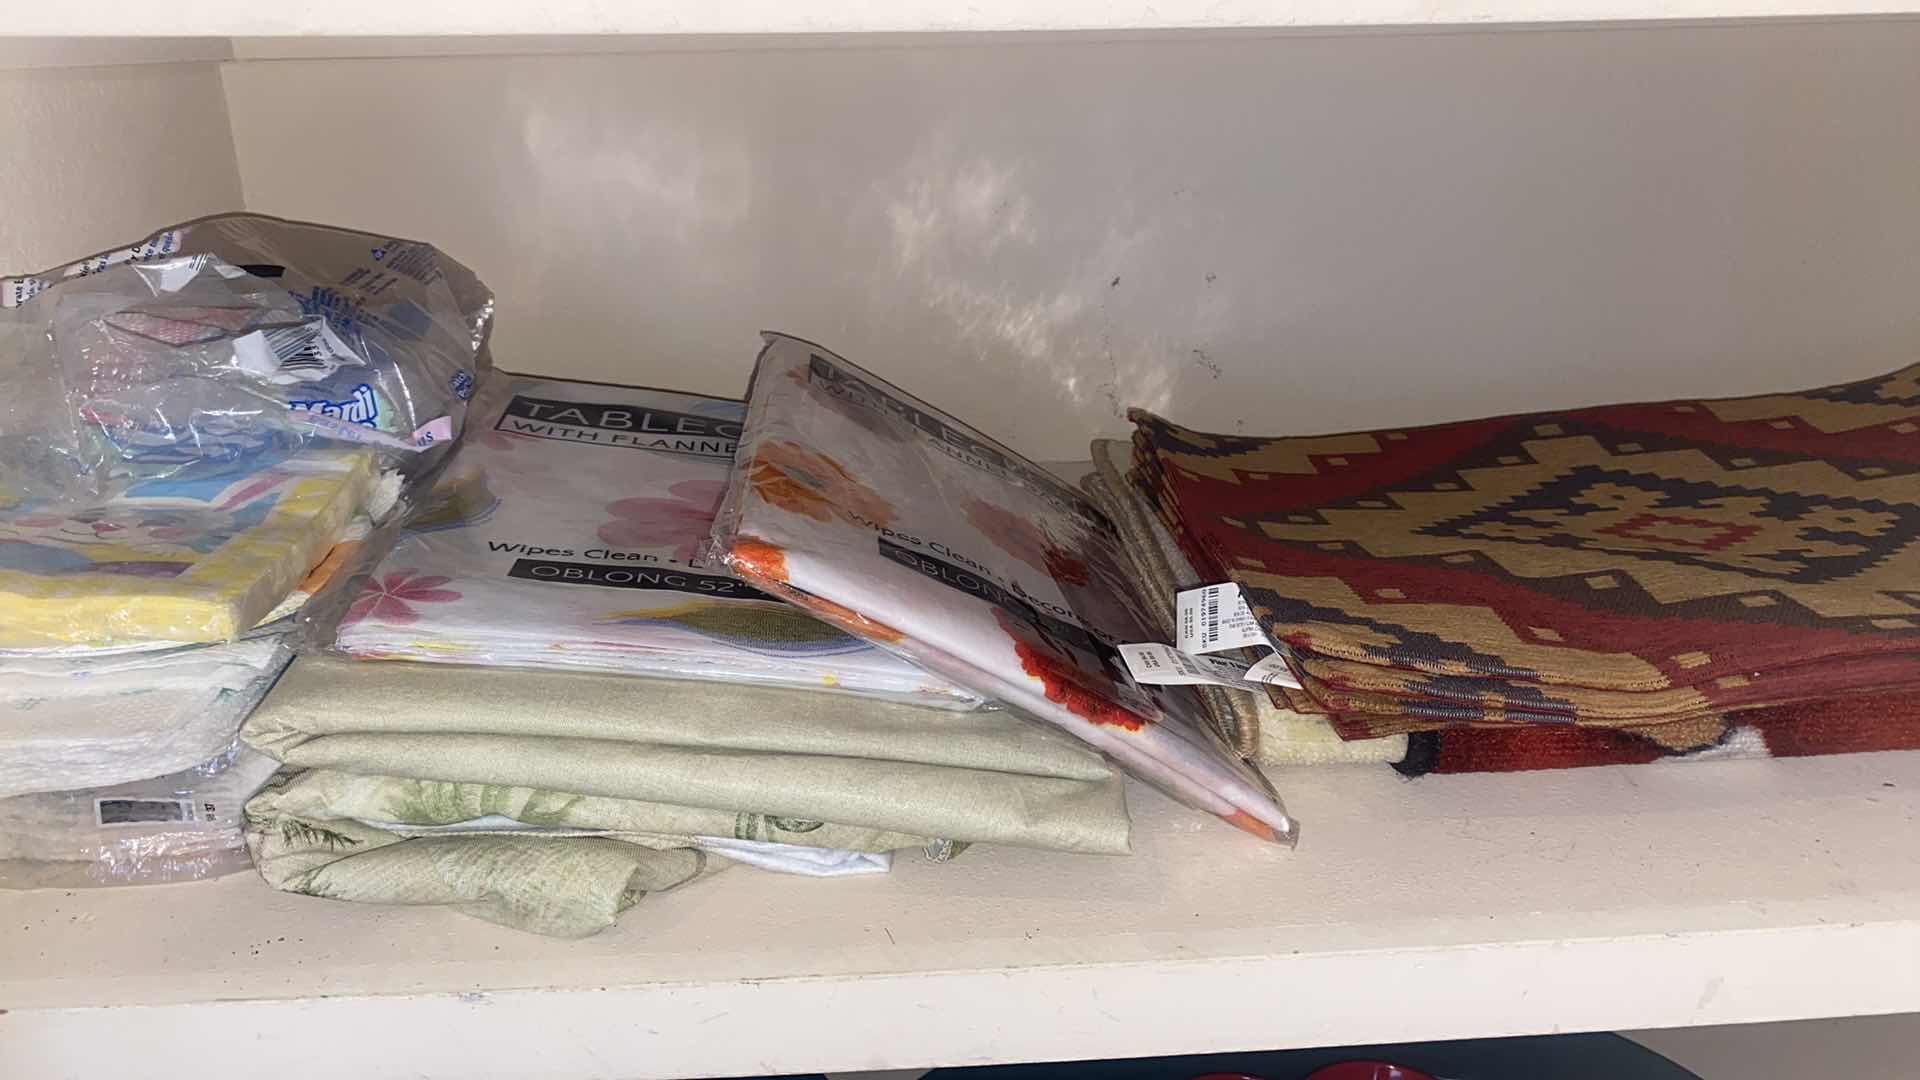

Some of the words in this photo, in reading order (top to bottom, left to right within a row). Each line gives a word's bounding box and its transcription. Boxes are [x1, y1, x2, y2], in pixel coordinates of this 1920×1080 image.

[512, 419, 598, 441] WITH
[488, 540, 575, 556] Wipes
[583, 548, 659, 564] Clean
[848, 509, 921, 546] Wipes
[928, 540, 992, 577] Clean
[530, 564, 687, 588] OBLONG
